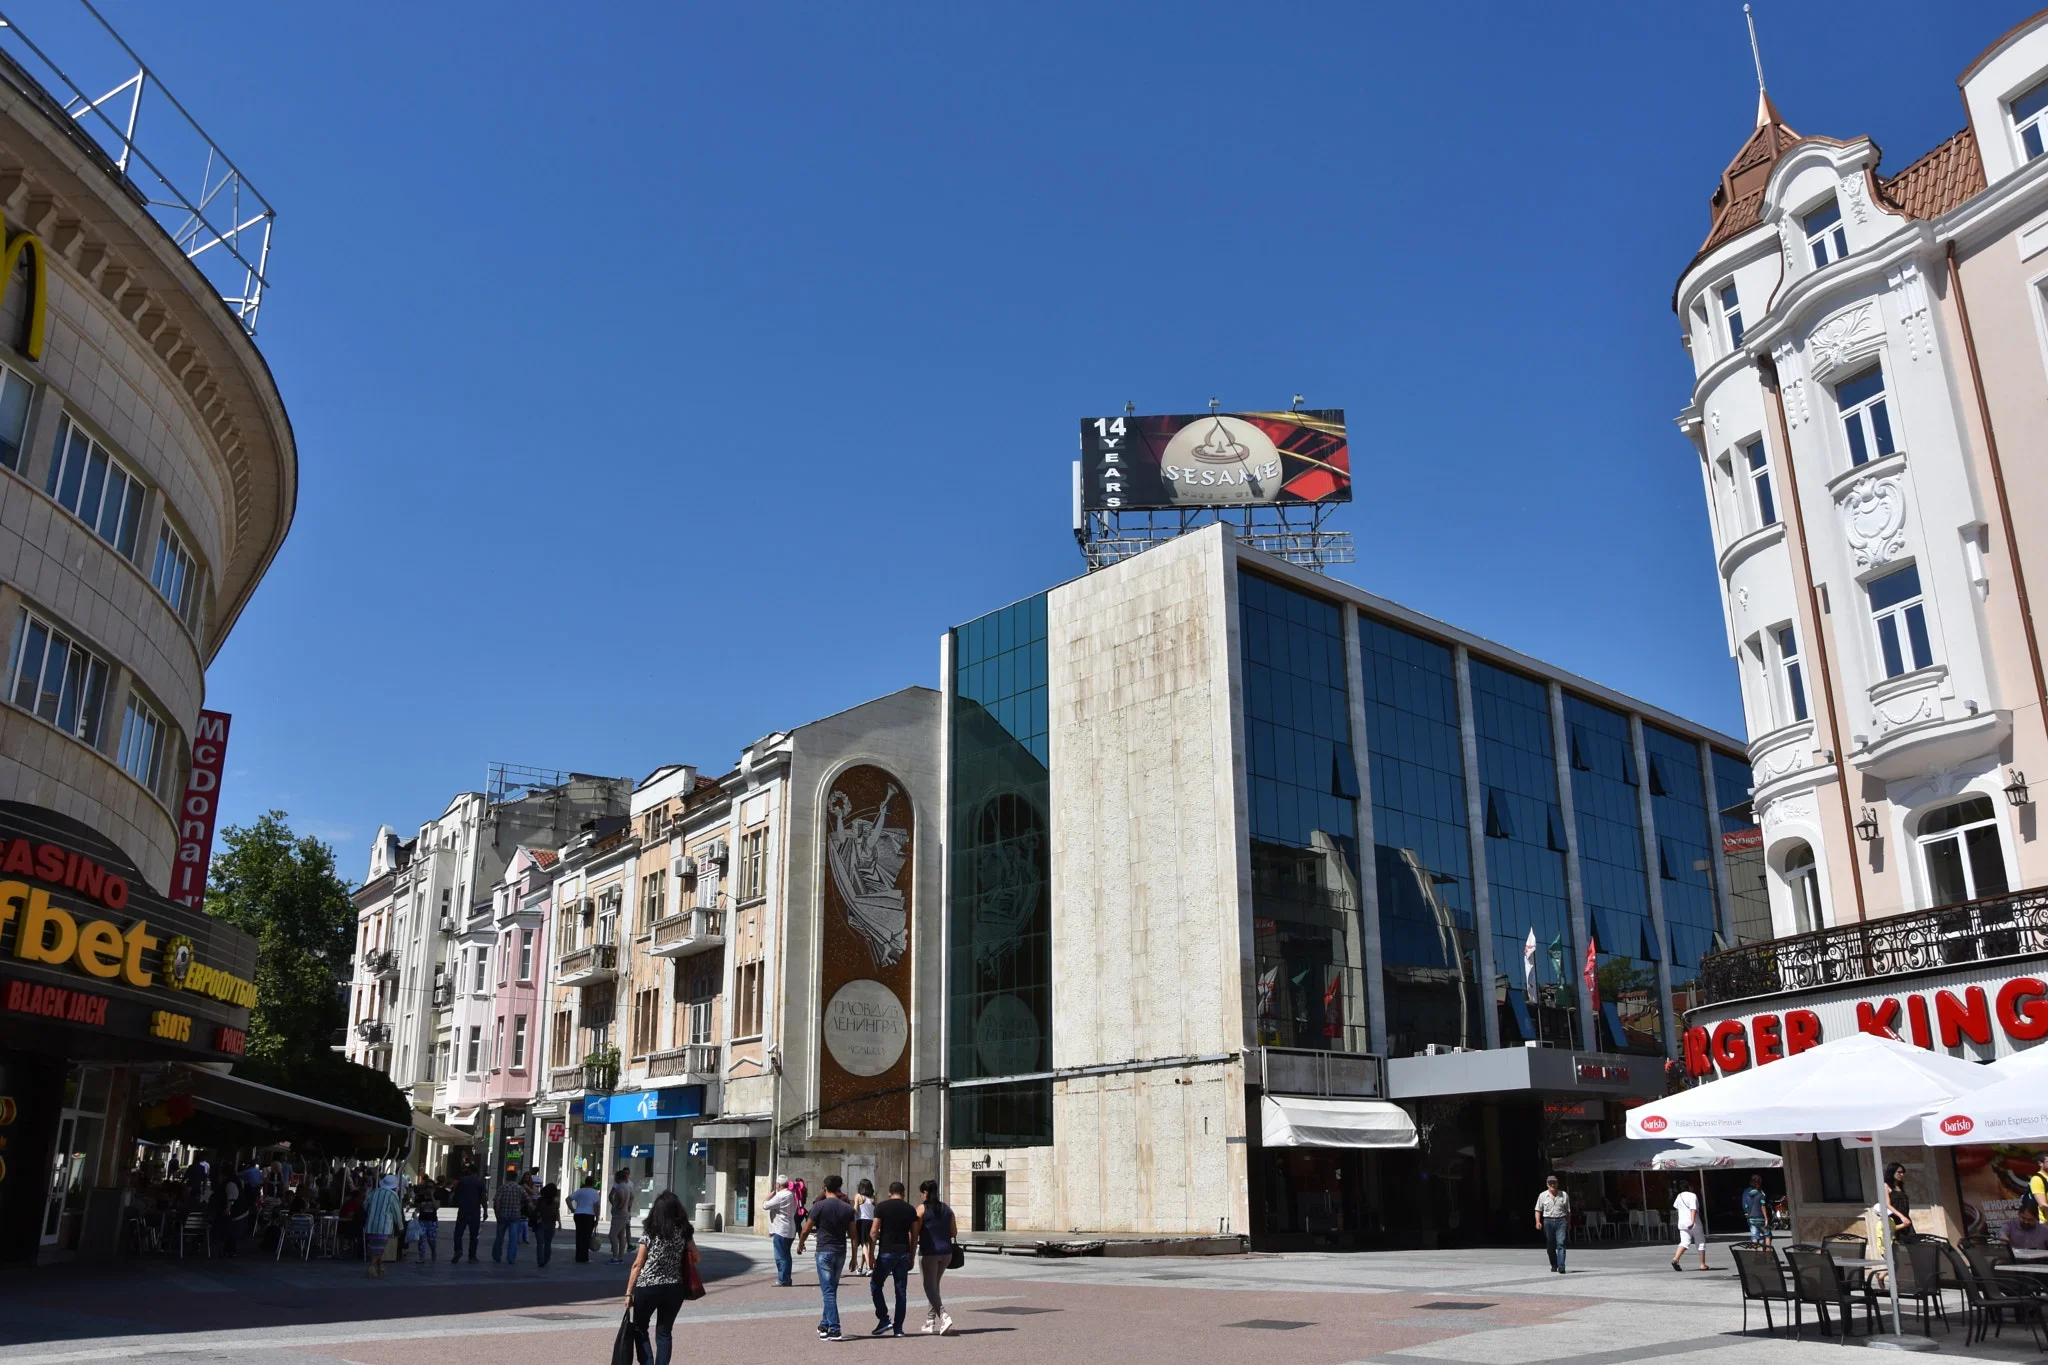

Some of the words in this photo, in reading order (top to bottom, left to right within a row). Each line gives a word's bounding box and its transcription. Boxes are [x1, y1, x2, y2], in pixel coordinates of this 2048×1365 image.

[1094, 417, 1127, 436] 14
[1103, 438, 1121, 507] YEARS
[1166, 460, 1279, 486] SESAME
[7, 980, 69, 1019] BLACK
[67, 988, 109, 1026] JACK
[1856, 977, 2048, 1049] KING
[155, 1010, 192, 1043] SLOTS
[220, 1027, 246, 1055] POKER
[1643, 1118, 1666, 1129] baristo
[1944, 1119, 1971, 1132] baristo
[1984, 1119, 2007, 1128] Italian
[2007, 1116, 2039, 1126] Espresso
